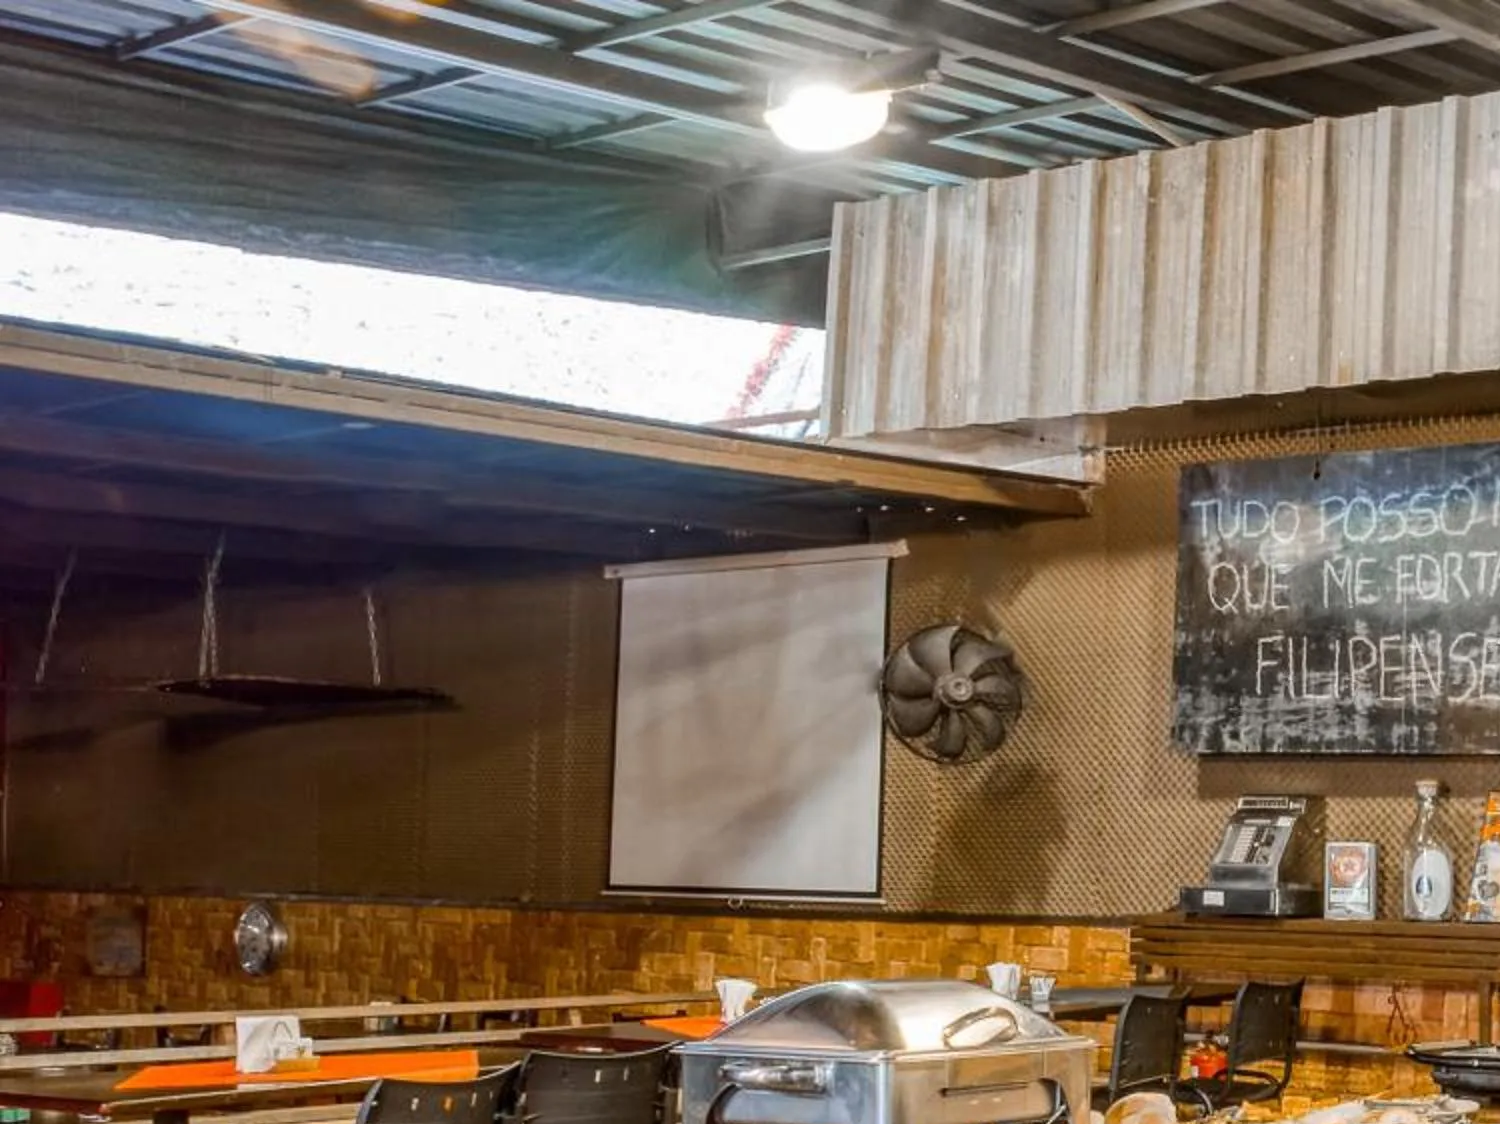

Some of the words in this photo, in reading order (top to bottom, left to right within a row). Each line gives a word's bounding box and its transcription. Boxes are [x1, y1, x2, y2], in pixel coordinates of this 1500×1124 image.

[1193, 499, 1300, 543] TUDO
[1318, 485, 1477, 543] POSSO
[1208, 564, 1290, 614] QUE
[1323, 557, 1379, 608] ME
